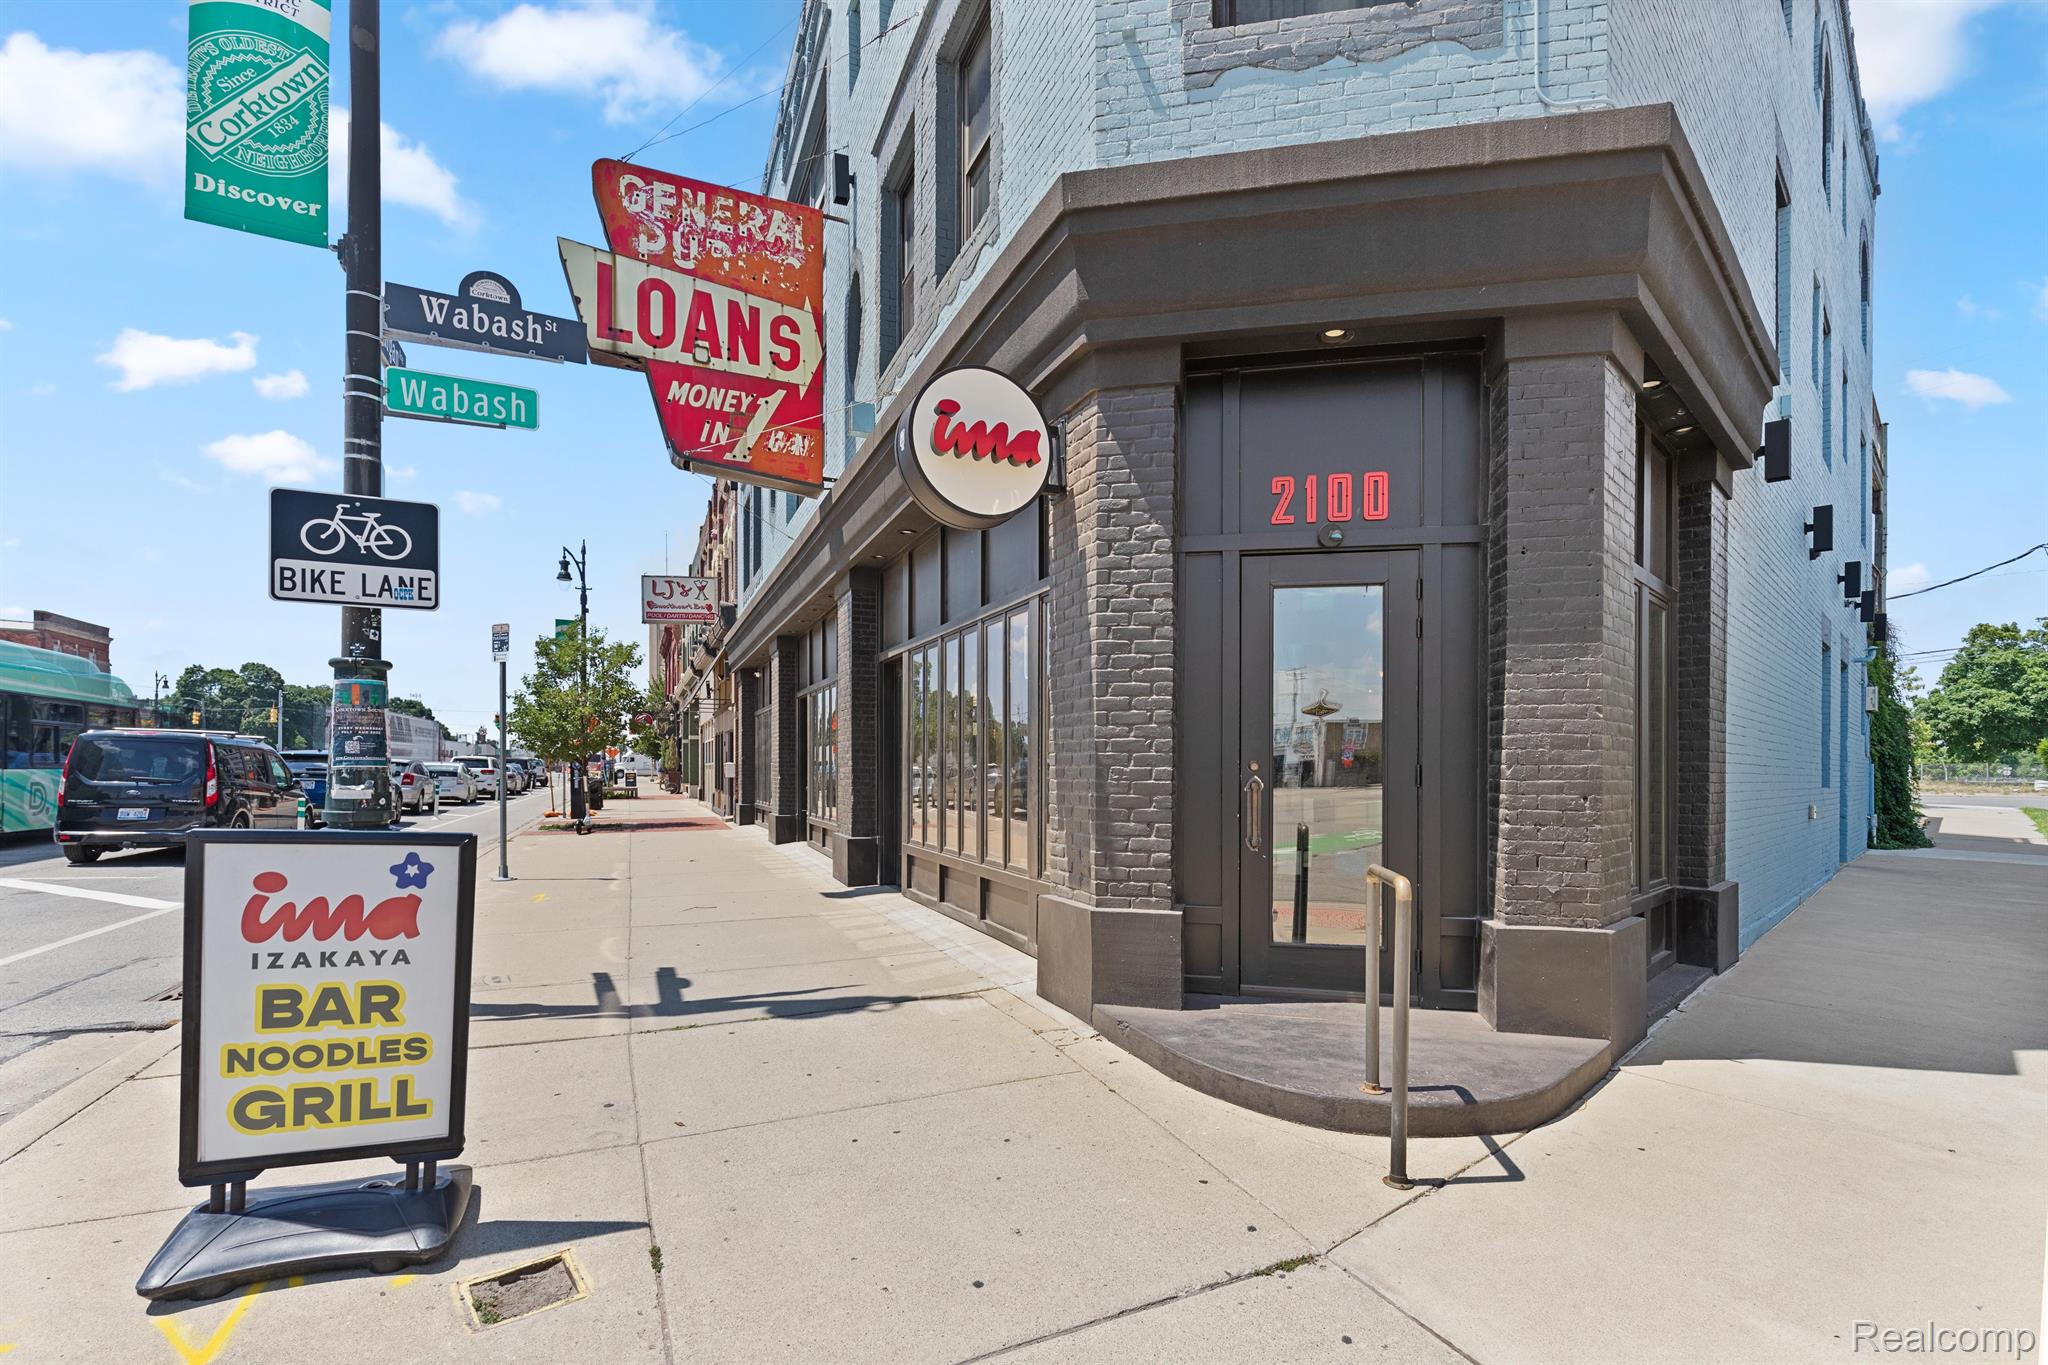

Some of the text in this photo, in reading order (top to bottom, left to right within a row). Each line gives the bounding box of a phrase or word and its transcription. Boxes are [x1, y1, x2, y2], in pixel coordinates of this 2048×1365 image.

[219, 37, 290, 60] OLDEST
[216, 67, 257, 93] Since
[197, 62, 326, 147] Corktown
[267, 115, 299, 138] 1834
[194, 172, 321, 217] Discover
[419, 294, 558, 345] Wabash St
[597, 261, 801, 372] LOANS
[400, 377, 526, 422] Wabash
[666, 380, 754, 414] MONEY
[700, 420, 730, 445] IN
[723, 389, 787, 463] 1
[931, 399, 1042, 467] ima
[1270, 471, 1389, 525] 2100
[279, 566, 346, 595] BIKE
[652, 579, 693, 600] LJ's
[241, 871, 422, 943] ima
[251, 949, 411, 970] IZAKAYA
[259, 983, 402, 1031] BAR
[225, 1036, 429, 1075] NOODLES
[231, 1077, 430, 1132] GRILL
